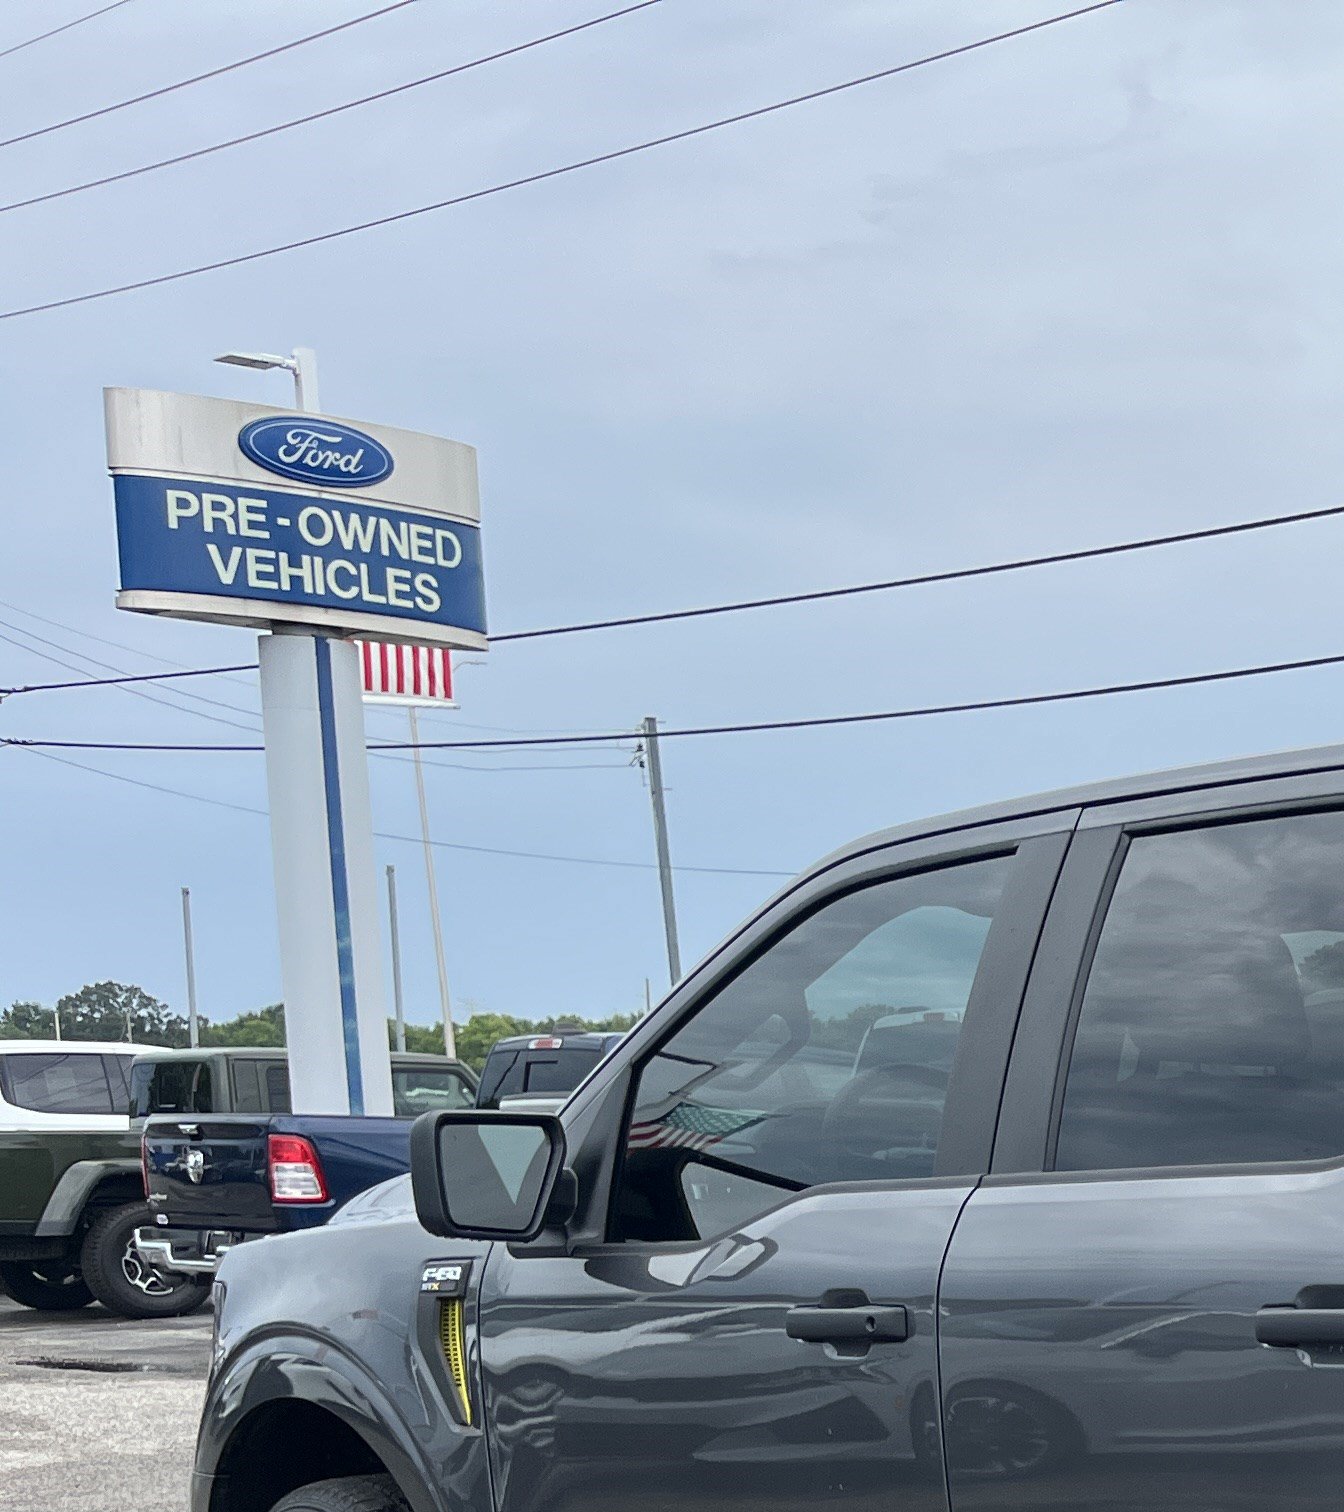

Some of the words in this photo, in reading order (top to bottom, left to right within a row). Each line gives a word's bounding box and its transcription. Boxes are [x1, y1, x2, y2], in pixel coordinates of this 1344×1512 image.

[277, 428, 364, 475] Ford
[165, 488, 463, 569] PRE-OWNED
[206, 543, 442, 613] VEHICLES
